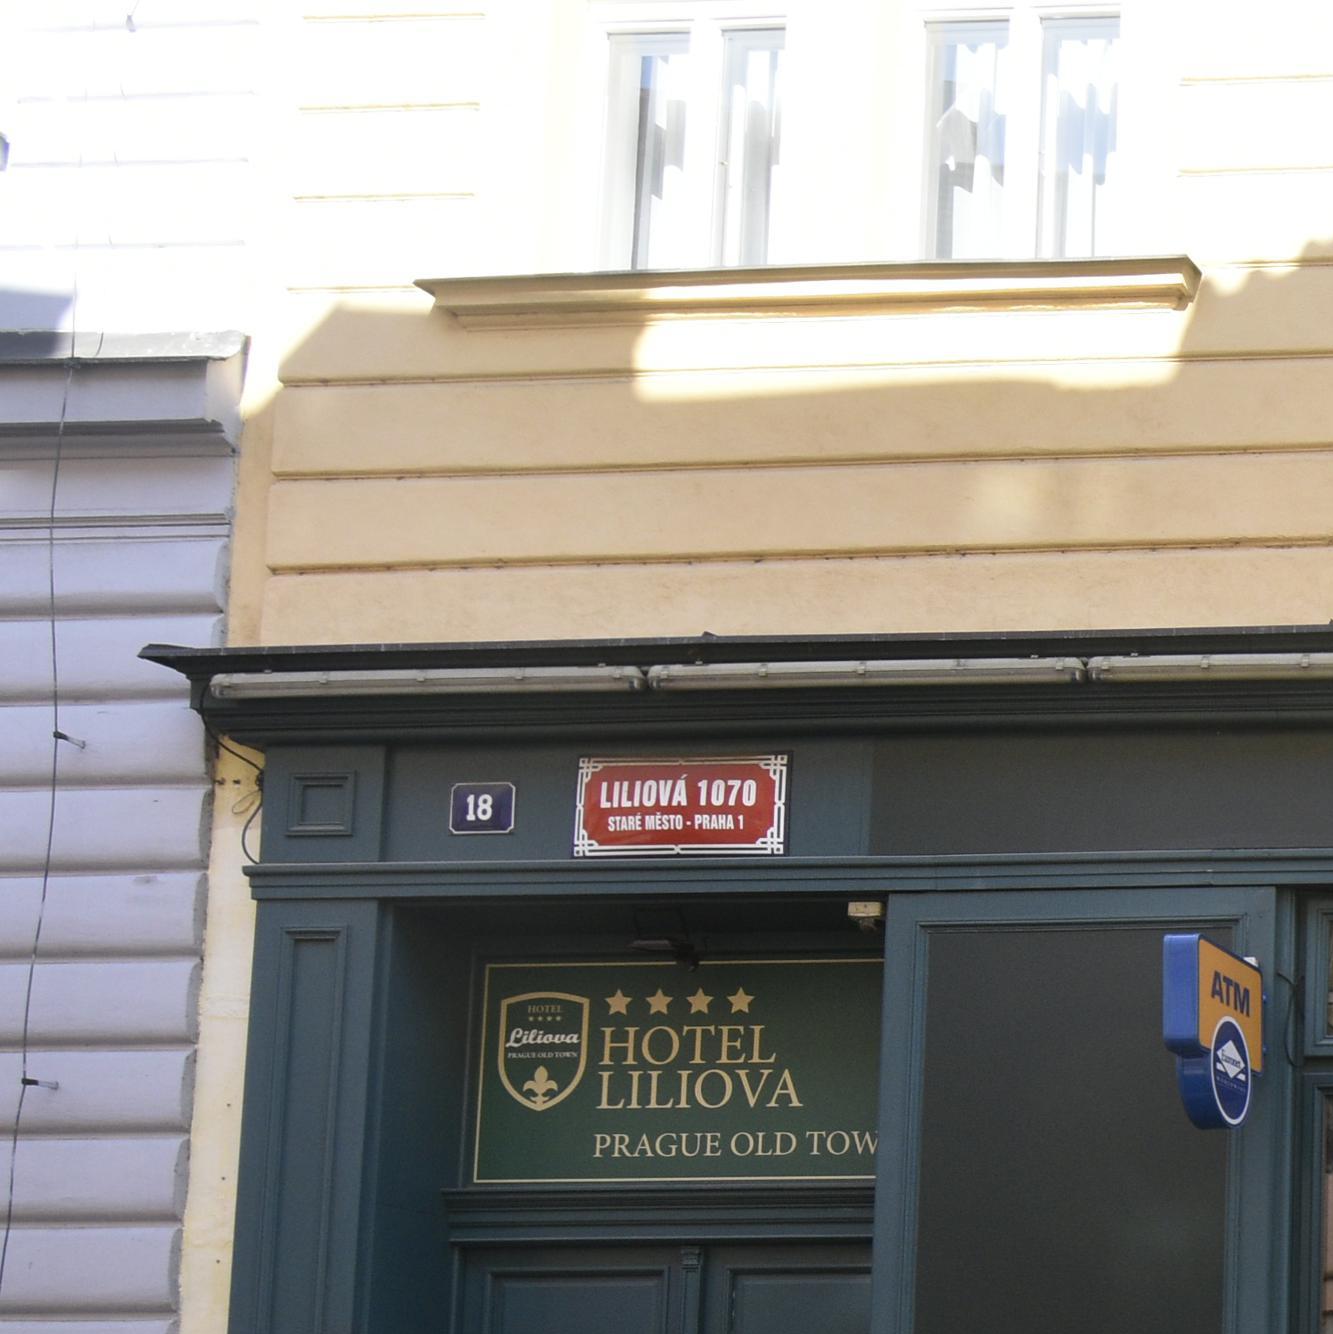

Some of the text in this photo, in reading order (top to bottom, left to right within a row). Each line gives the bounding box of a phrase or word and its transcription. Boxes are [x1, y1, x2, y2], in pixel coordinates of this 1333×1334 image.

[599, 774, 757, 808] LILIOVÁ 1070
[466, 793, 493, 821] 18
[608, 813, 642, 831] STARÉ
[645, 812, 683, 831] MĚSTO
[695, 814, 735, 830] PRAHA
[738, 815, 744, 830] 1
[1211, 970, 1250, 1017] ATM
[528, 1005, 561, 1013] HOTEL
[505, 1028, 580, 1047] Liliova
[598, 1025, 777, 1065] HOTEL
[596, 1069, 804, 1109] LILIOVA
[593, 1133, 722, 1158] PRAGUE
[730, 1131, 797, 1156] OLD
